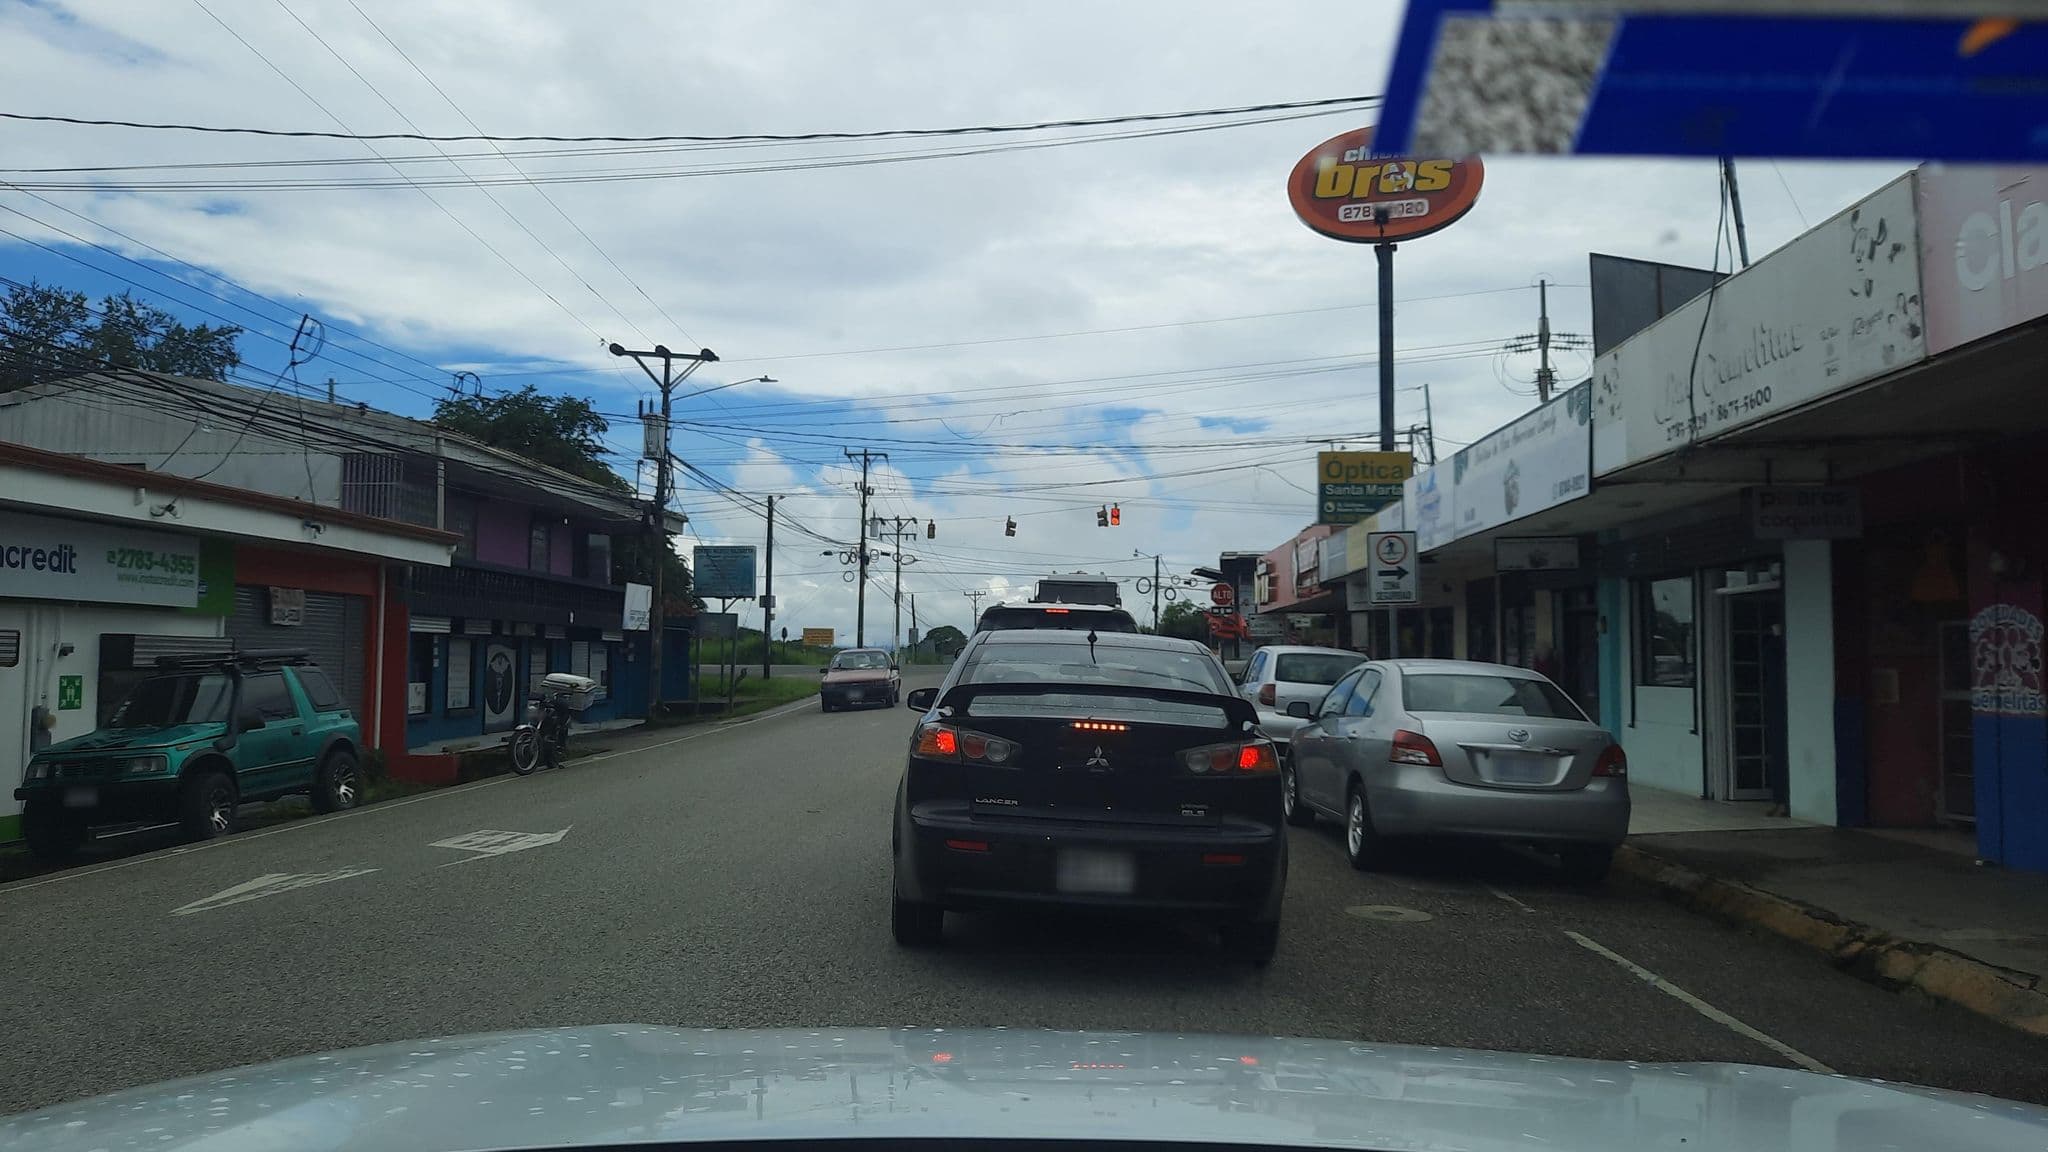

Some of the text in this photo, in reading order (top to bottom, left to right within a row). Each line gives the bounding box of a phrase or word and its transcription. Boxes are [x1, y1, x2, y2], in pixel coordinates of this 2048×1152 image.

[1315, 156, 1454, 198] bros
[1326, 456, 1404, 482] Óptica
[1325, 484, 1404, 495] Santa Marta
[117, 548, 194, 574] 2783-4355
[1213, 590, 1232, 600] ALTO
[975, 797, 1019, 807] LANCER
